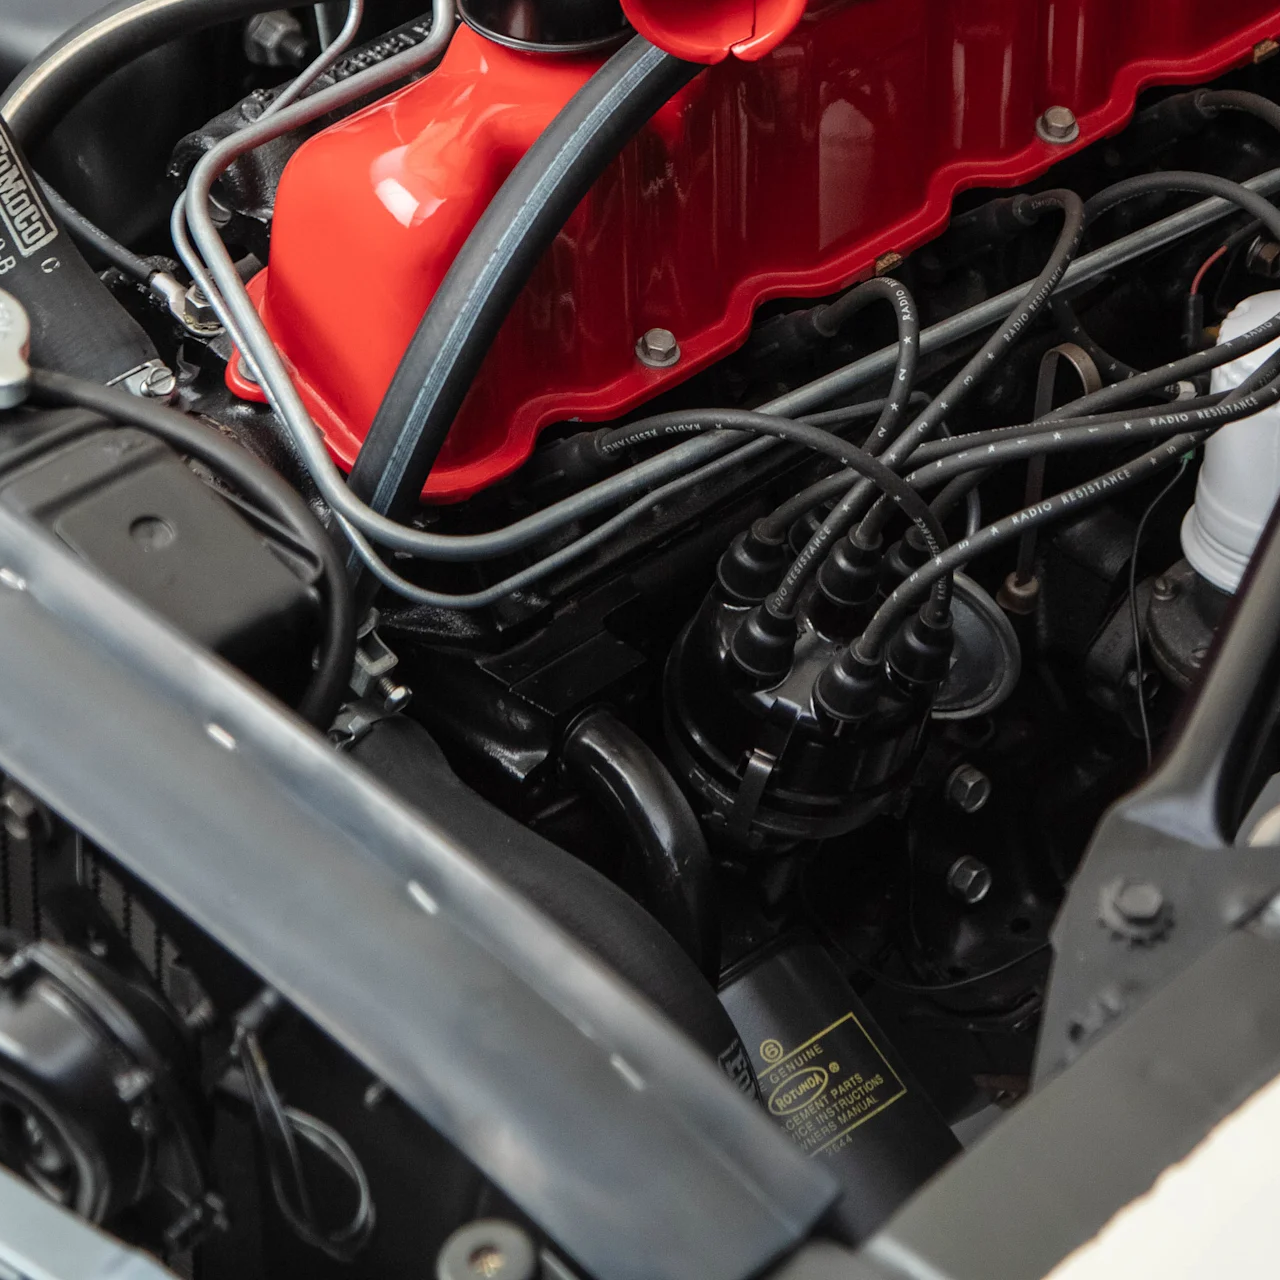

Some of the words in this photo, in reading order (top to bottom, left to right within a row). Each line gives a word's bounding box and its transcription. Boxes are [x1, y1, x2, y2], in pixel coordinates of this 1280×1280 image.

[896, 290, 915, 321] RADIO
[1003, 312, 1029, 343] RADIO
[1028, 265, 1063, 312] RESISTANCE
[964, 375, 974, 386] 3
[664, 422, 702, 434] RADIO
[917, 421, 928, 433] 3
[1149, 413, 1189, 428] RADIO
[1196, 396, 1259, 420] RESISTANCE
[1011, 501, 1053, 525] RADIO
[1060, 468, 1132, 506] RESISTANCE
[786, 524, 832, 586] RESISTANCE
[769, 1043, 824, 1084] GENUINE
[775, 1072, 824, 1111] ROTUNDA
[815, 1073, 885, 1126] INSTRUCTIONS
[830, 1072, 864, 1100] PARTS
[837, 1094, 880, 1126] MANUAL
